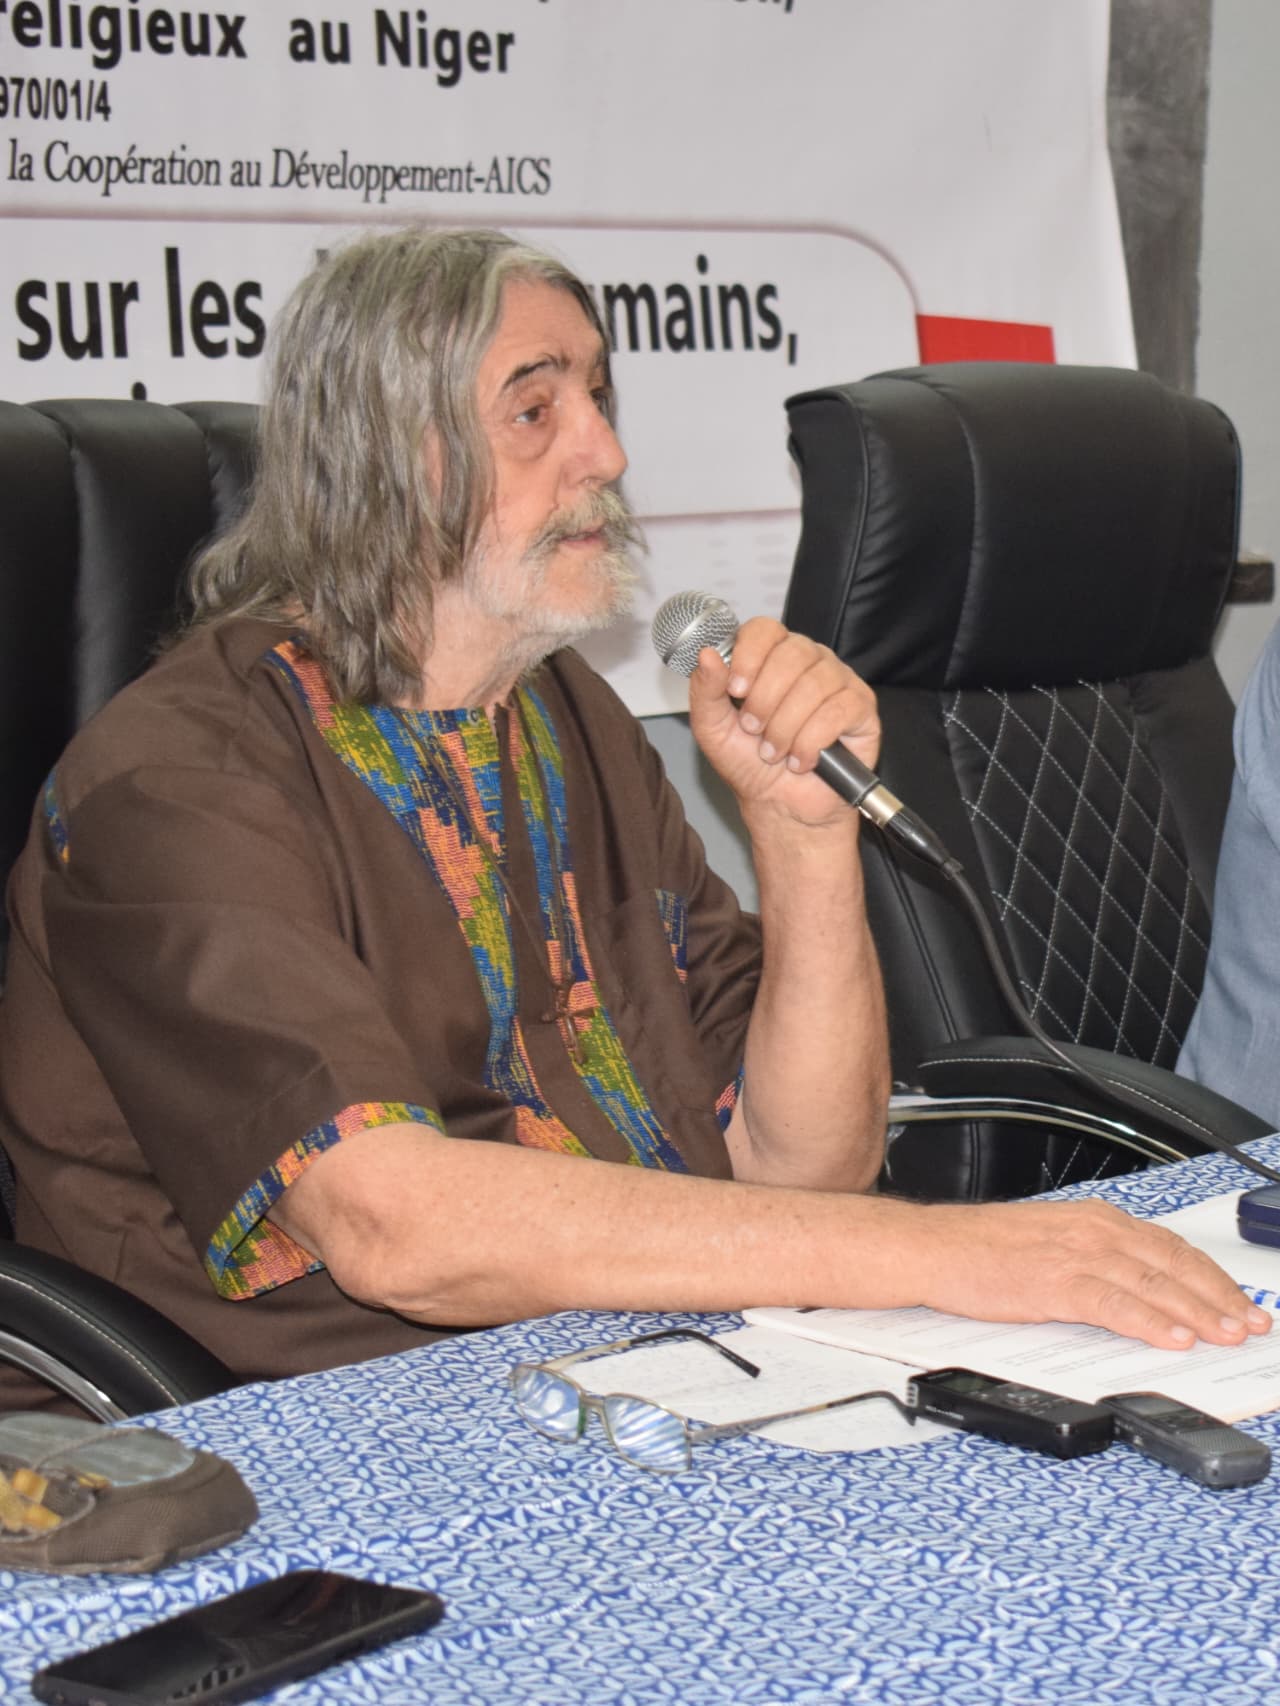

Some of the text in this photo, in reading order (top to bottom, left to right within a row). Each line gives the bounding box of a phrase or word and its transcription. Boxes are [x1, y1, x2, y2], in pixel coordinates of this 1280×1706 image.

[288, 18, 351, 65] au
[375, 8, 515, 88] Niger
[7, 137, 552, 203] la Coopération au Développement-AICS
[15, 246, 798, 366] sur les mains,
